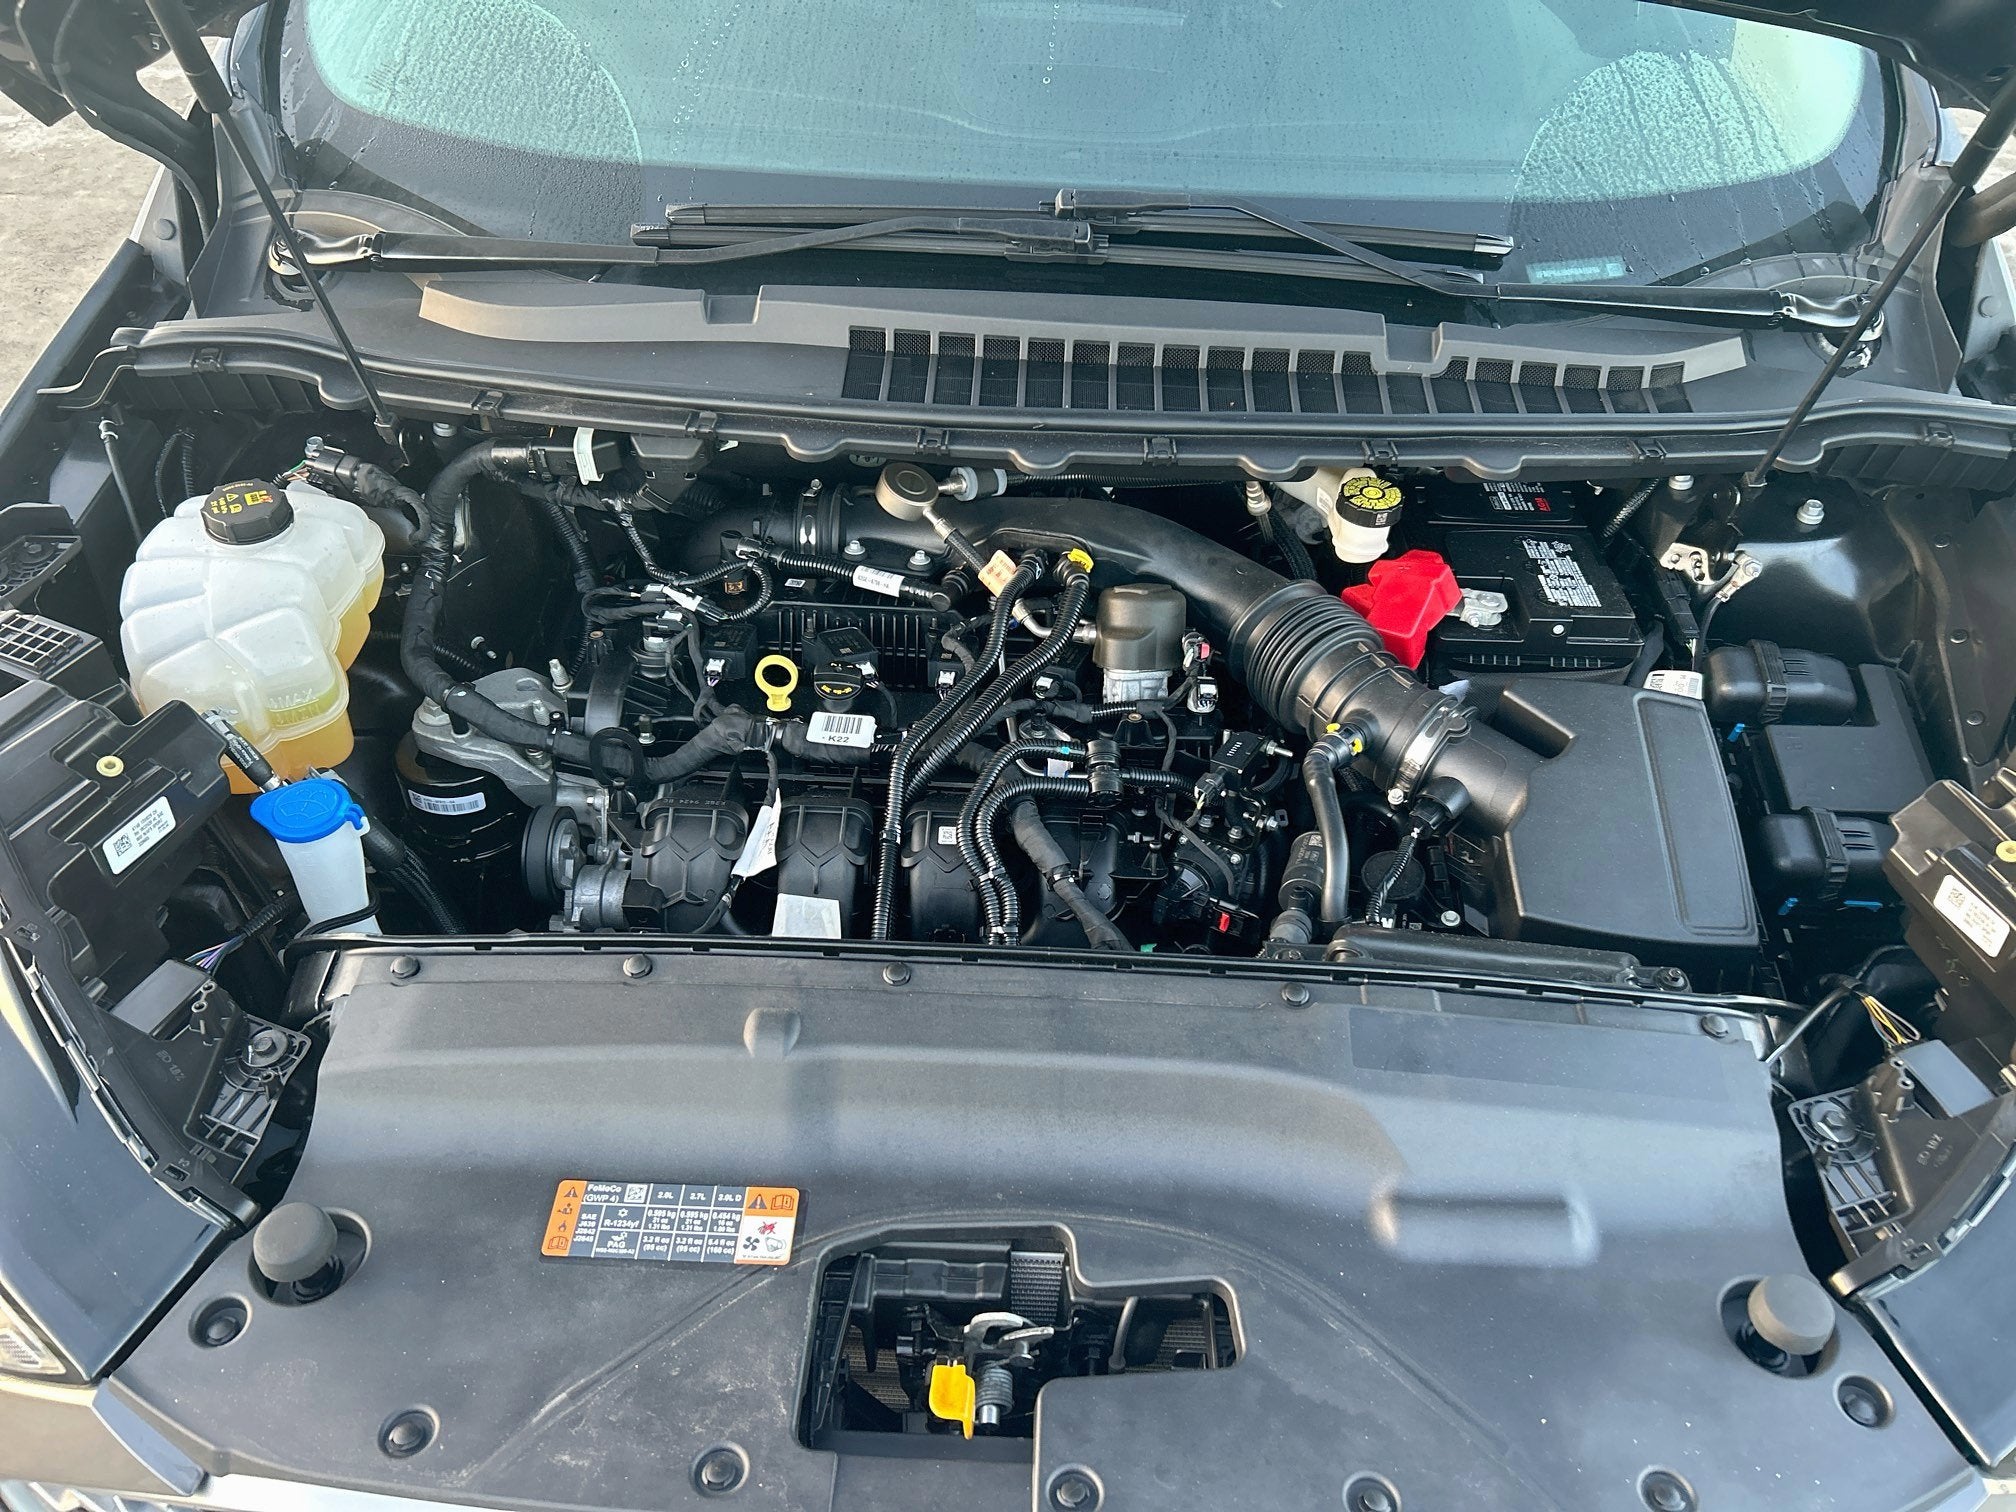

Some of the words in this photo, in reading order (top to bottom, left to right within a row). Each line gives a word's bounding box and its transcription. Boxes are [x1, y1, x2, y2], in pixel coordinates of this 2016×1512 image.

[828, 735, 849, 743] K22
[587, 1184, 622, 1193] FoMoCo
[583, 1194, 609, 1203] (GWP
[609, 1194, 620, 1204] 4)
[657, 1191, 674, 1199] 2.0L
[667, 1210, 677, 1219] kg
[699, 1210, 709, 1220] kg
[731, 1212, 741, 1222] kg
[603, 1219, 640, 1229] R-1234yf
[607, 1241, 626, 1249] PAG
